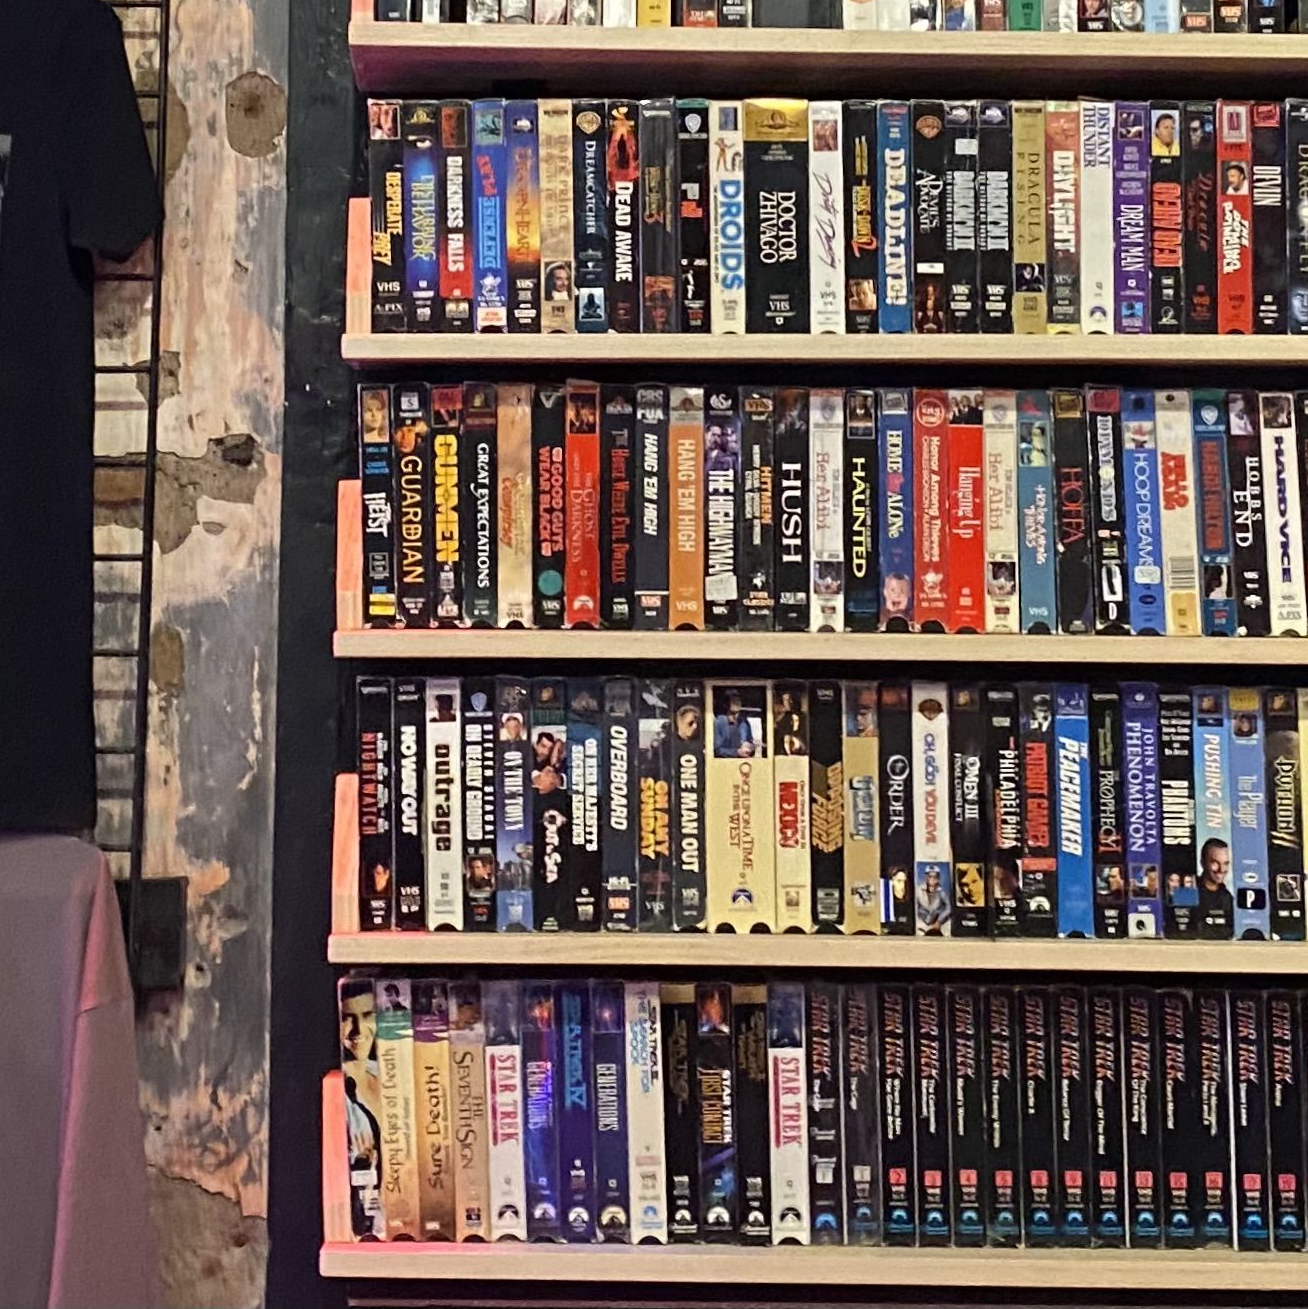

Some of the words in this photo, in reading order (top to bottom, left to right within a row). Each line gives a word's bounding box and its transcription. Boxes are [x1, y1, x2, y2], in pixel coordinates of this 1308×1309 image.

[1084, 105, 1097, 168] THUNDER
[1097, 106, 1110, 169] DISTANT
[448, 156, 463, 228] DARKNESS
[585, 141, 597, 234] DREAMCATCHER
[616, 182, 633, 226] DEAD
[1049, 151, 1075, 252] DAYLIGHT
[448, 233, 464, 272] FALLS
[616, 231, 631, 281] AWAKE
[721, 179, 743, 290] DROIDS
[760, 192, 776, 263] ZHIVAGO
[777, 192, 796, 262] DOCTOR
[885, 148, 907, 305] DEADLINE!
[477, 443, 489, 483] GREAT
[1247, 456, 1262, 521] HOBBS
[400, 456, 423, 583] GUARDIAN
[435, 435, 459, 562] GUNMEN
[781, 462, 802, 562] HUSH
[852, 458, 866, 578] HAUNTED
[1233, 490, 1252, 547] END
[471, 489, 489, 588] EXPECTATIONS
[610, 726, 627, 830] OVERBOARD
[680, 754, 697, 788] ONE
[1143, 728, 1154, 766] JOHN
[1203, 734, 1221, 797] PUSHING
[432, 744, 454, 851] outrage
[681, 792, 698, 839] MAN
[1058, 737, 1082, 856] PEACEMAKER
[1126, 722, 1145, 851] PHENOMENON
[1145, 774, 1156, 844] TRAVOLTA
[1162, 780, 1191, 845] PHANTOMS
[1205, 804, 1222, 827] TIN
[682, 841, 699, 872] OUT
[453, 1051, 474, 1127] SEVENTH
[498, 1054, 517, 1093] STAR
[597, 1064, 619, 1130] GENERATIONS
[474, 1095, 483, 1120] THE
[499, 1099, 519, 1142] TREK
[431, 1142, 443, 1189] Sure
[456, 1130, 476, 1170] SIGN
